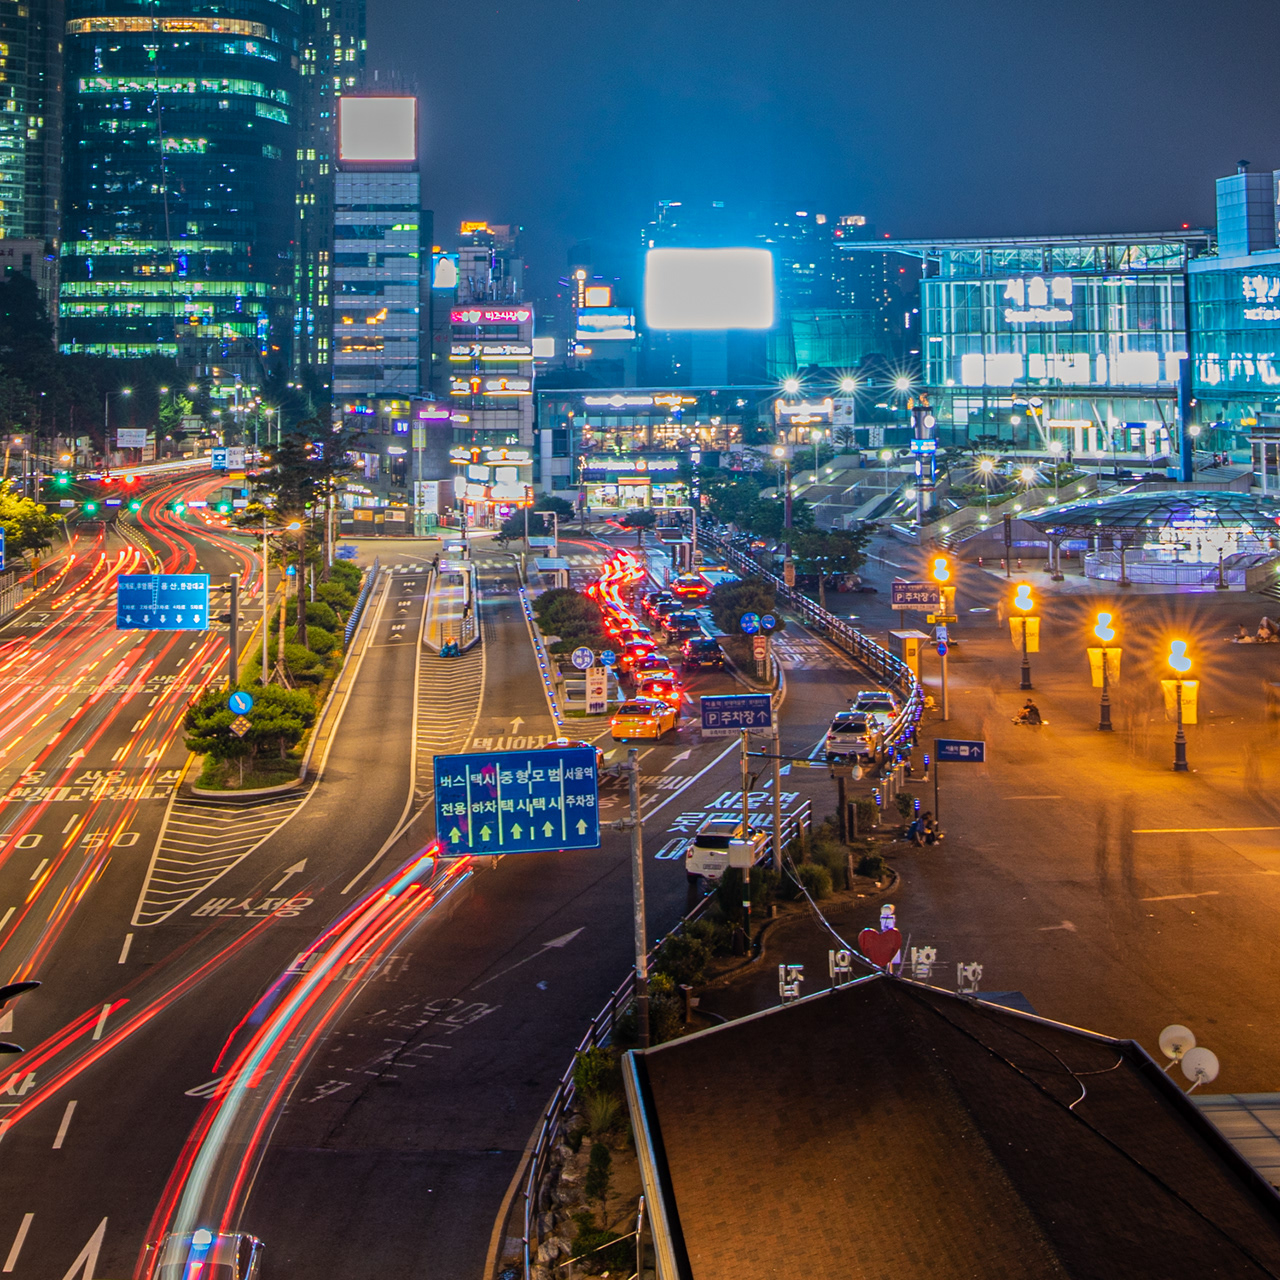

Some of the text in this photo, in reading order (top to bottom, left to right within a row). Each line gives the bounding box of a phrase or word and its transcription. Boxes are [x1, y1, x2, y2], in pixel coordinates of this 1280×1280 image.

[1004, 277, 1073, 306] 서울역
[905, 593, 929, 602] 주차장
[721, 711, 755, 725] 주차장
[440, 775, 466, 787] 버스
[470, 773, 496, 786] 택시
[564, 767, 594, 780] 서울역
[440, 794, 595, 816] 전용 하차 택시 택시 주차장
[79, 831, 141, 850] 50
[190, 897, 315, 918] 버스전용
